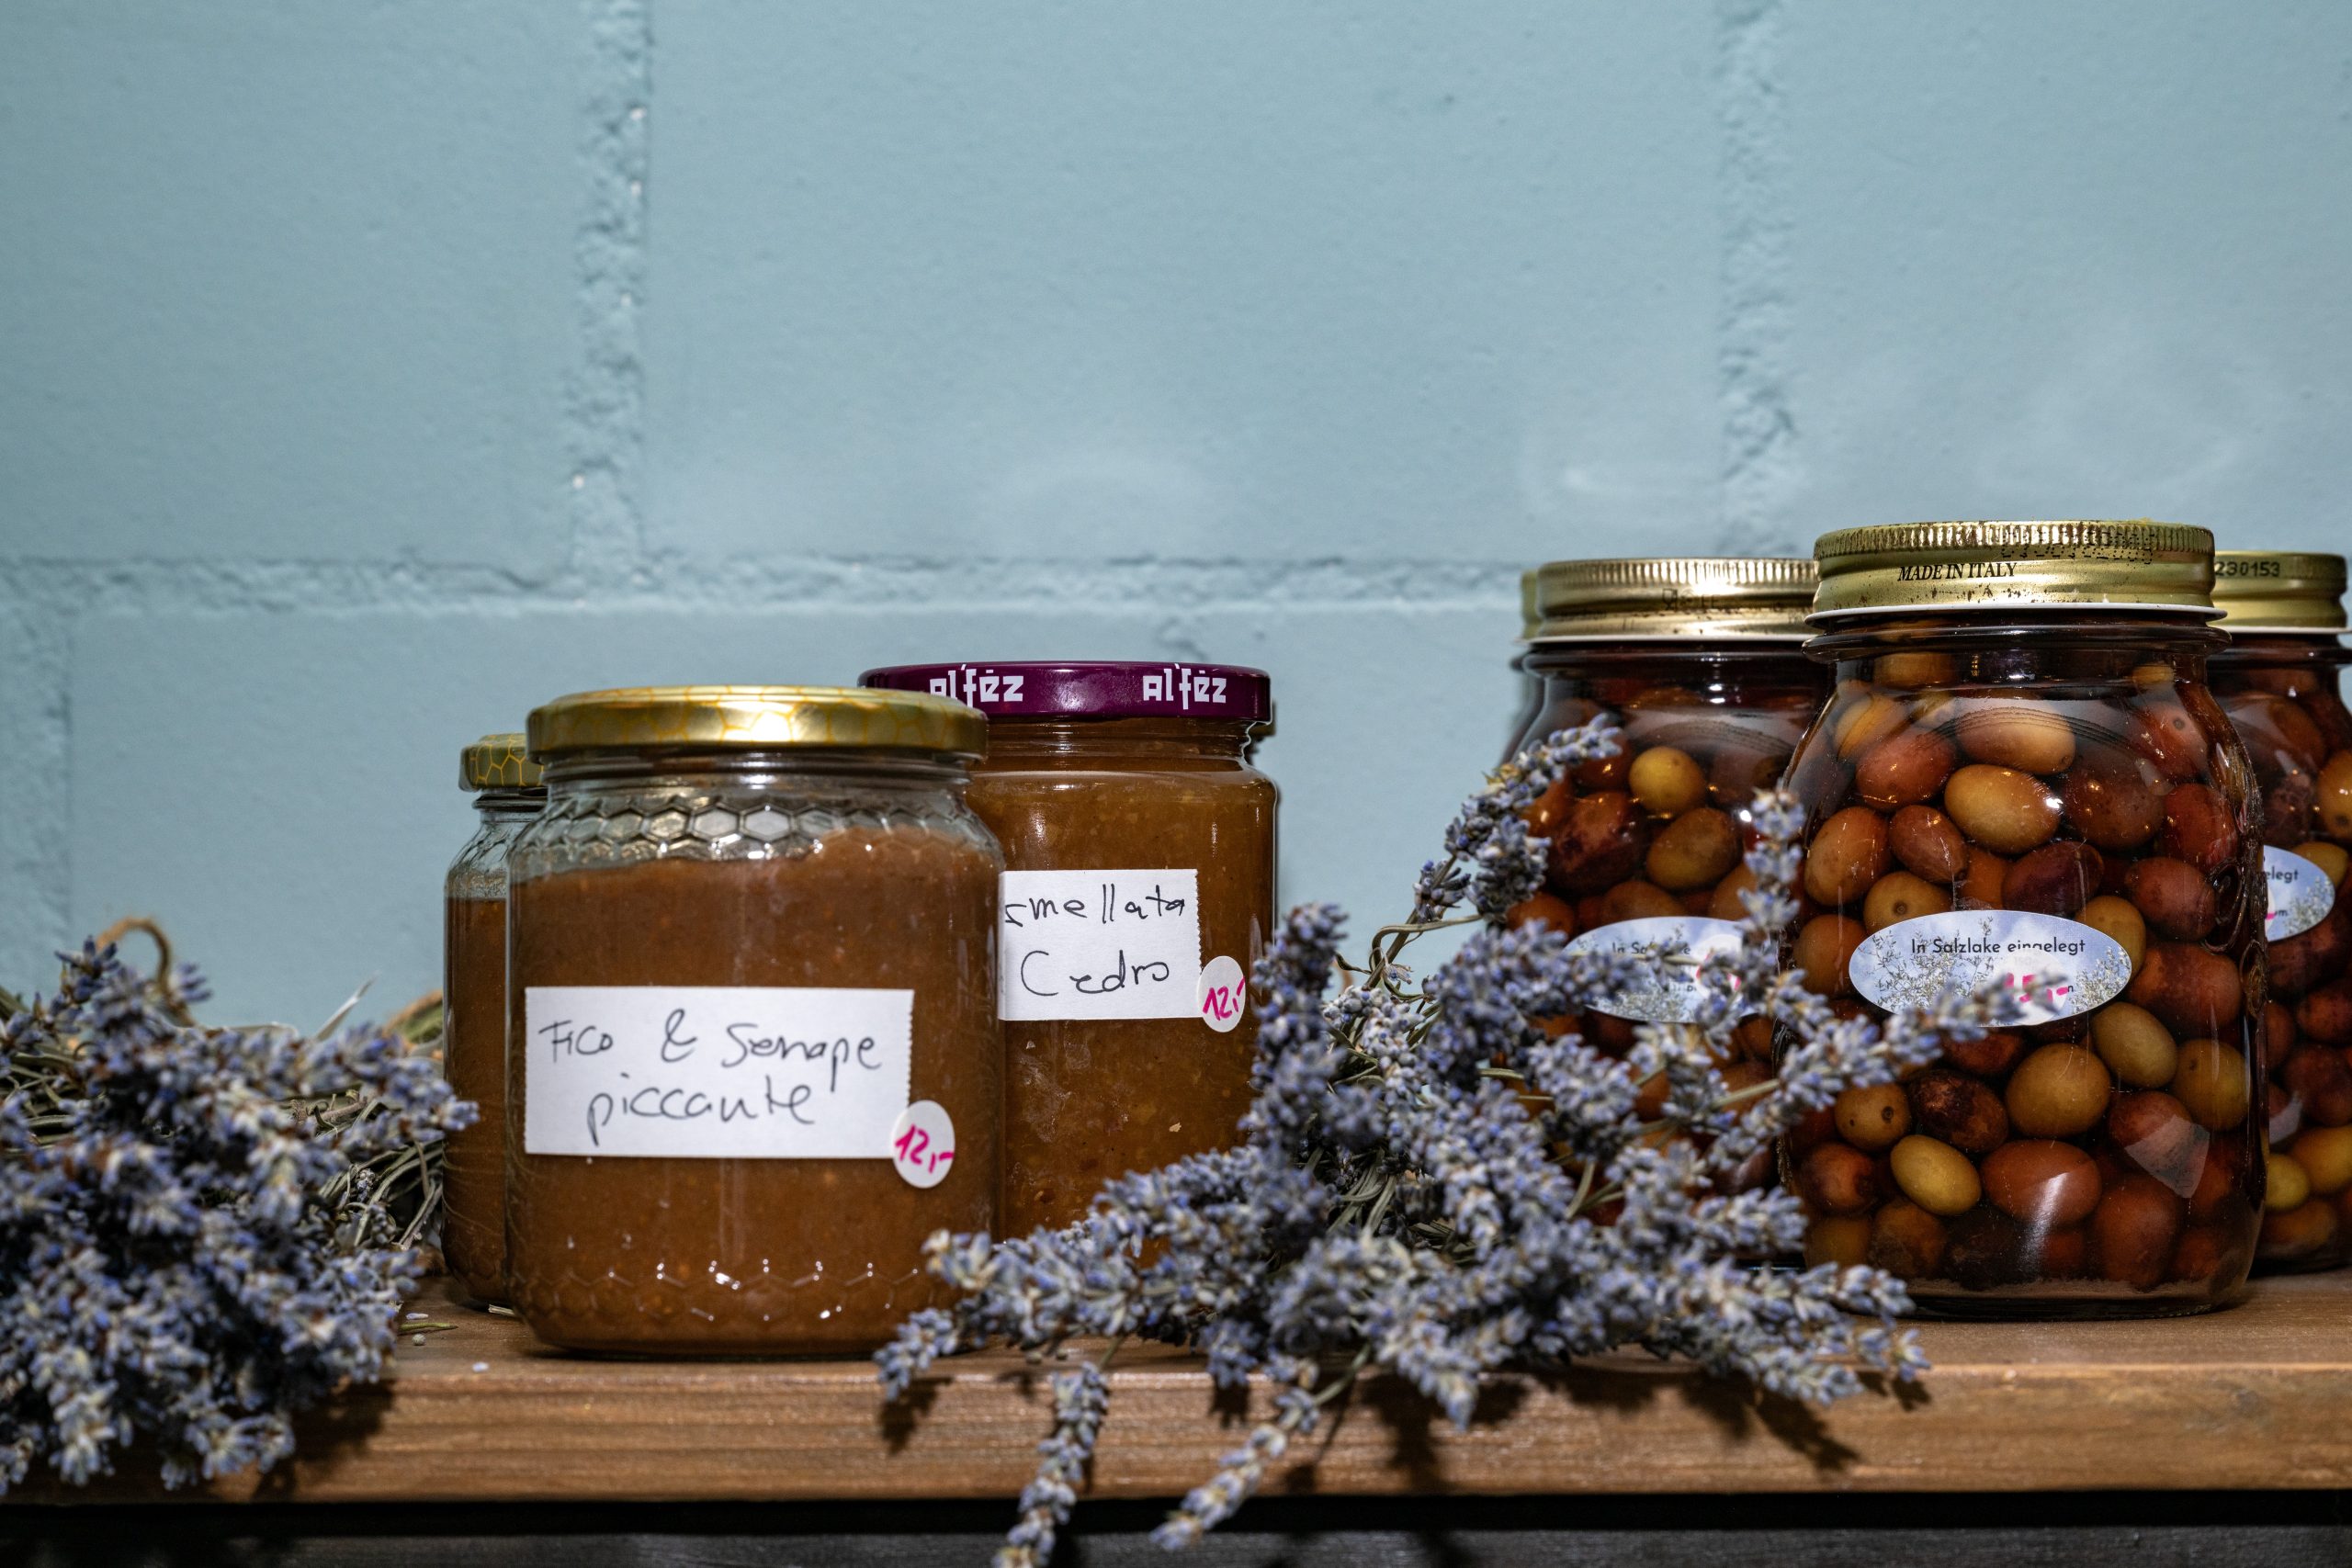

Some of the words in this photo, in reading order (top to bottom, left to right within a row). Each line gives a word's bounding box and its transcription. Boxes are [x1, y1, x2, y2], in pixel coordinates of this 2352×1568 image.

[1897, 563, 1942, 581] MADE
[1945, 563, 1966, 580] IN
[1968, 562, 2018, 579] ITALY
[1912, 939, 1926, 953] In
[1933, 937, 2001, 954] Salzlake
[1020, 949, 1170, 997] Cedro
[661, 1008, 697, 1064] &
[721, 1021, 882, 1093] Senape
[586, 1072, 816, 1147] piccante
